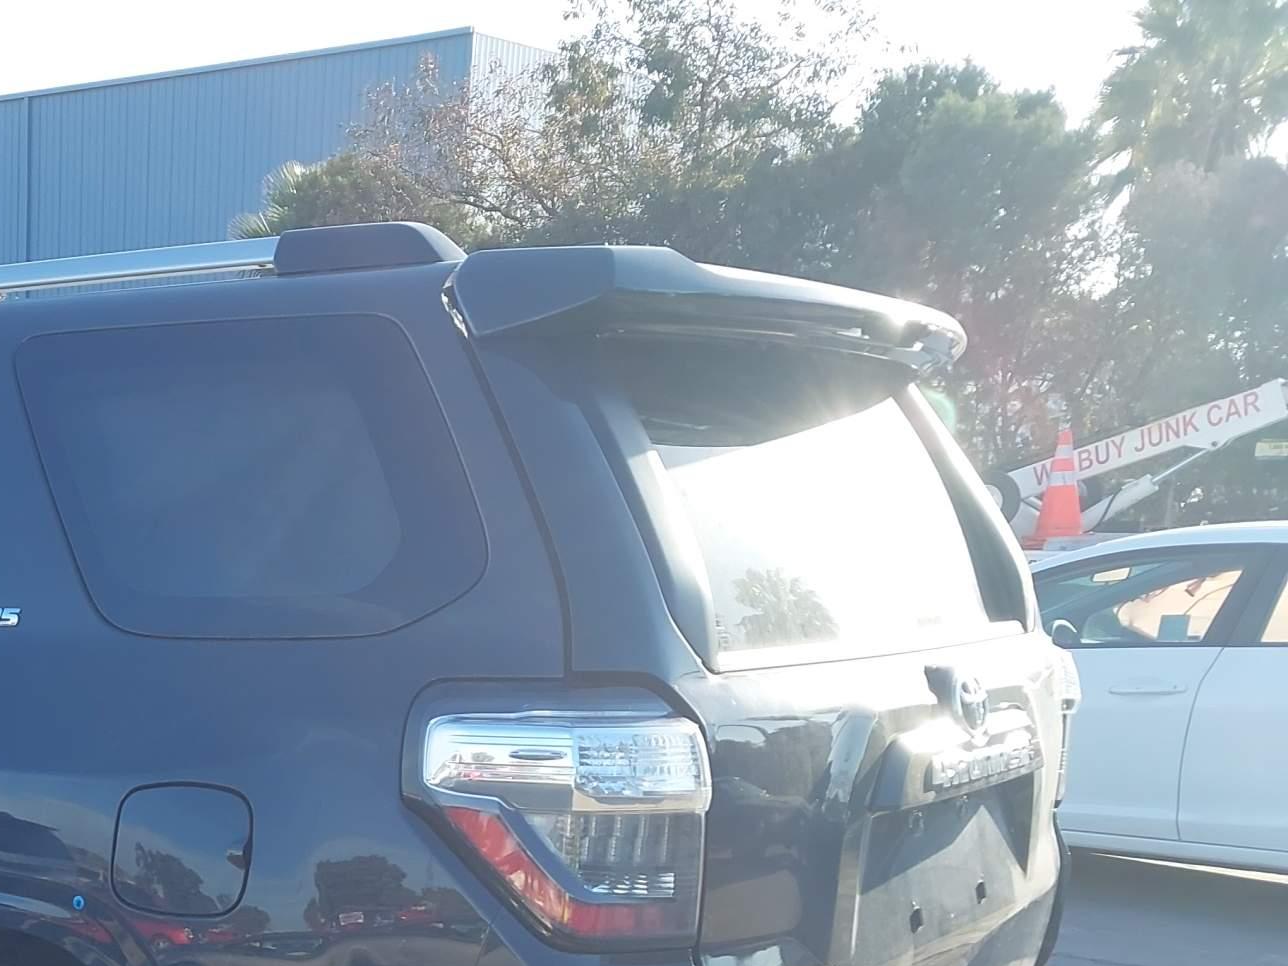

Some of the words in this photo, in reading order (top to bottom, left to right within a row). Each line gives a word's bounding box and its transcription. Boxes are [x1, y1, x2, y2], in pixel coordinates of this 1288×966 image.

[1077, 438, 1126, 472] BUY
[1133, 411, 1200, 453] JUNK
[1206, 391, 1261, 427] CAR
